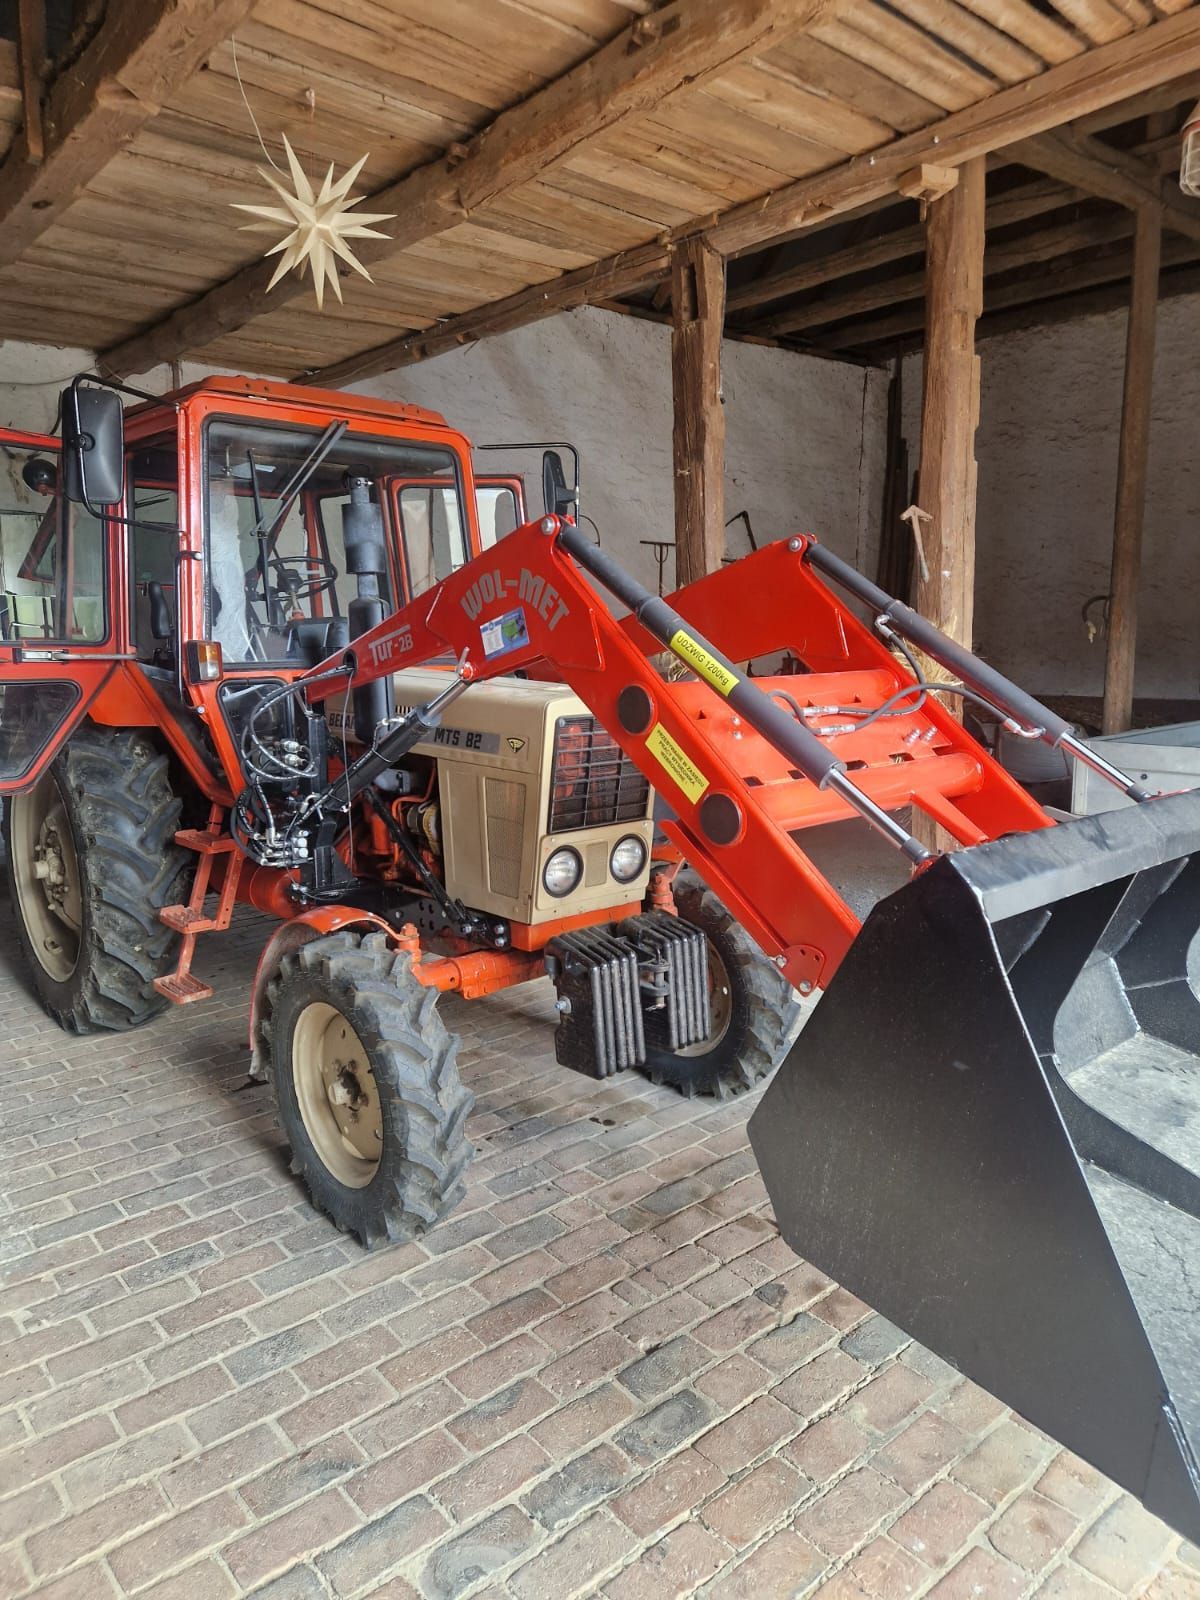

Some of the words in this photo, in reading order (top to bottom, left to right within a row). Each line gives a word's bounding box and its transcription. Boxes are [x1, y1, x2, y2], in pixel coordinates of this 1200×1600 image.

[460, 568, 570, 631] WOL-MET
[704, 660, 730, 686] 1200kg
[433, 727, 461, 746] MTS
[466, 732, 483, 749] 82
